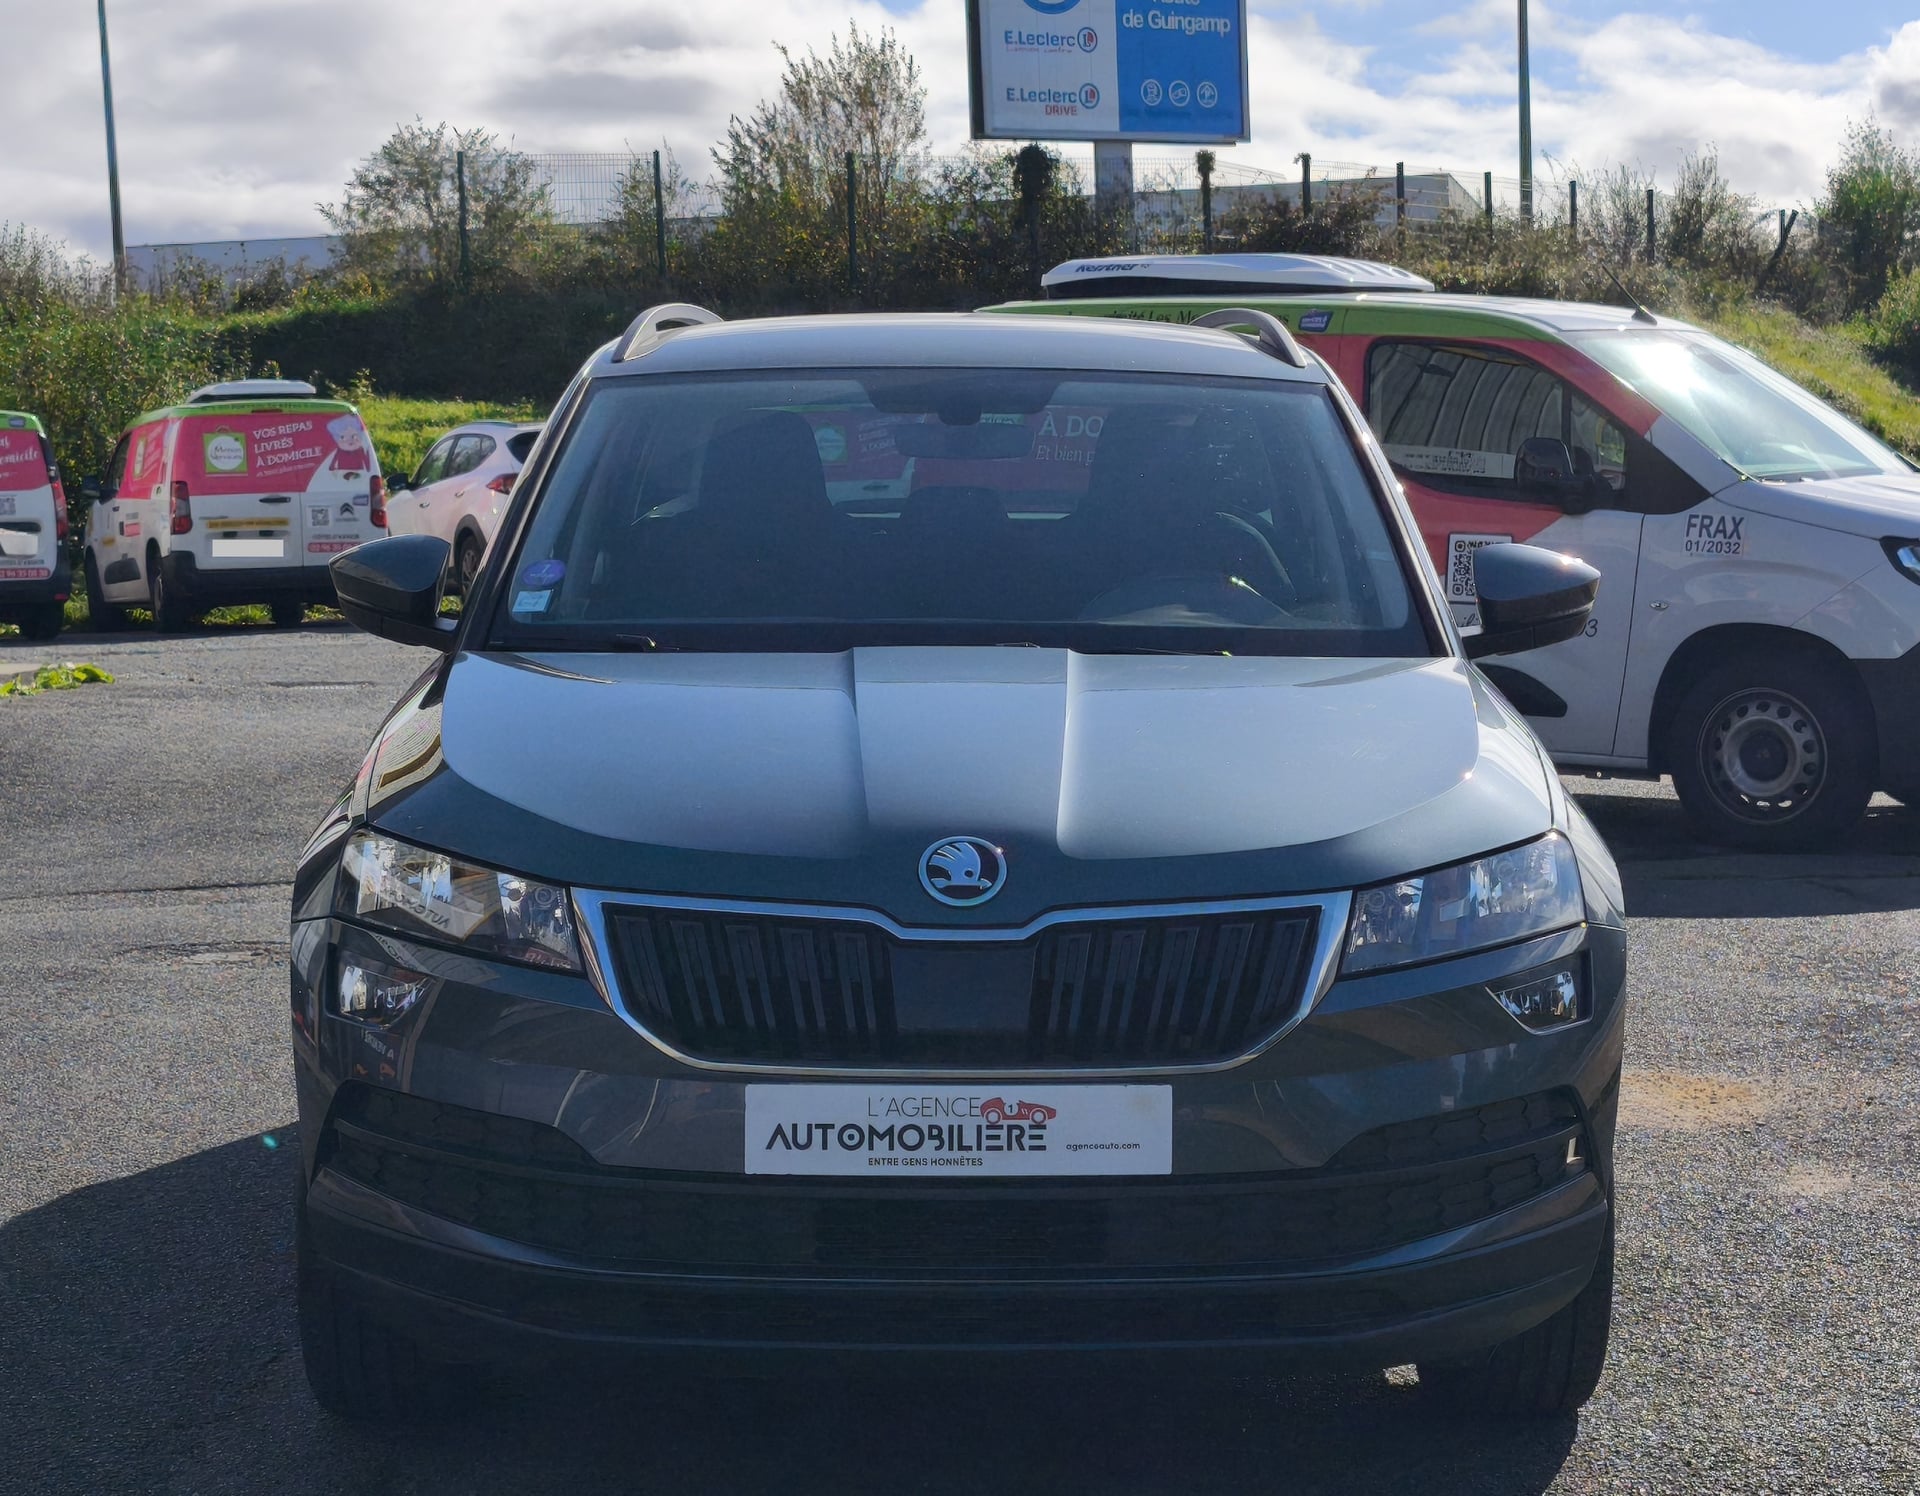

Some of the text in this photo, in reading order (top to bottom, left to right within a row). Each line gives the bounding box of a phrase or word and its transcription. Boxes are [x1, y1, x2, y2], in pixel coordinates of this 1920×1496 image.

[1123, 9, 1231, 37] de Guingamp
[1004, 30, 1076, 47] E.Leclerc
[1006, 87, 1078, 104] E.Leclerc
[1045, 104, 1078, 116] DRIVE
[253, 420, 313, 440] VOS REPAS
[267, 446, 323, 465] DOMICILE
[1686, 514, 1744, 540] FRAX
[1685, 540, 1741, 554] 01/2032
[1066, 1141, 1141, 1151] agenceauto.com
[868, 1157, 899, 1166] ENTRE
[902, 1157, 928, 1166] GENS
